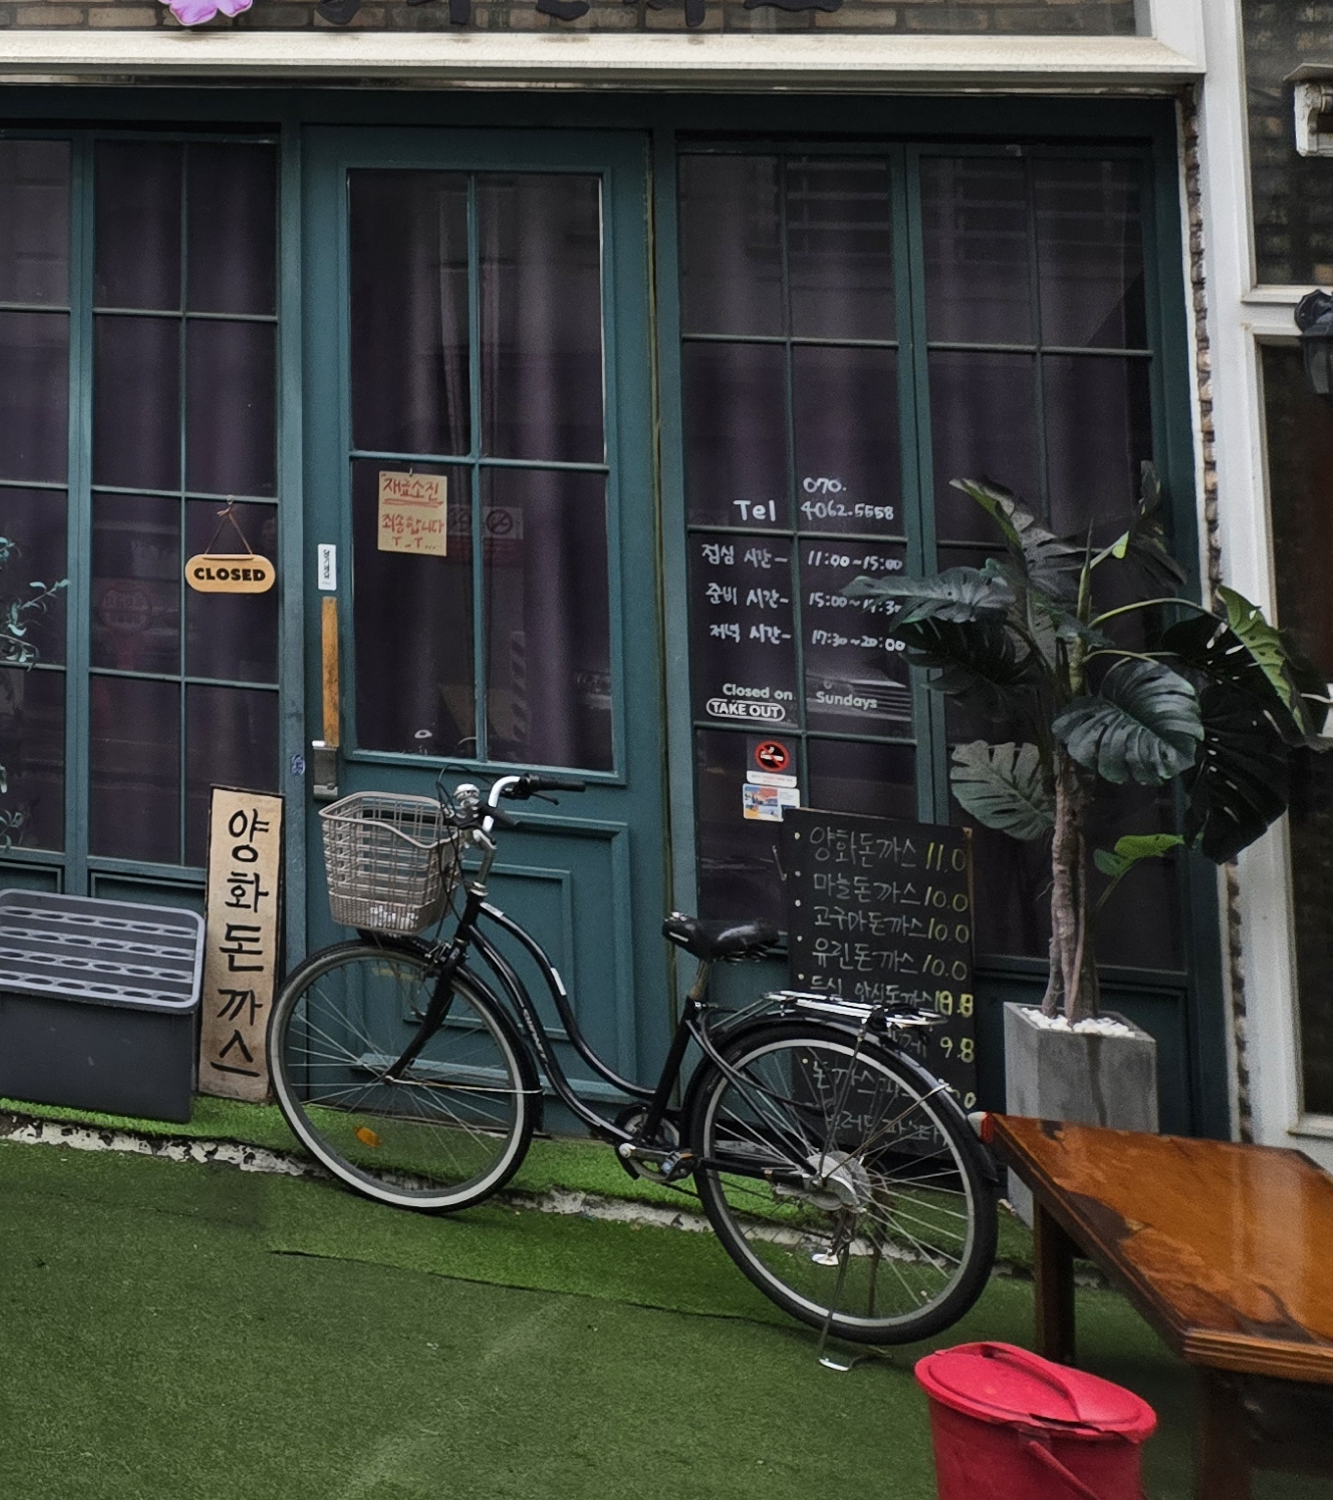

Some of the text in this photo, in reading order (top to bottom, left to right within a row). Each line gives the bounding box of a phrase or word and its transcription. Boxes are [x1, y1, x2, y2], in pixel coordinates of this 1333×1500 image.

[733, 499, 776, 522] Tel
[382, 513, 444, 535] 죄송합니다
[702, 544, 734, 565] 점심
[194, 567, 266, 582] CLOSED
[705, 583, 737, 605] 준비
[710, 623, 740, 643] 저녁
[722, 683, 878, 711] Closed on Sundays
[711, 701, 780, 719] TAKE OUT
[809, 826, 917, 867] 양화돈까스
[813, 871, 969, 912] 마늘돈까스 10.0
[813, 905, 969, 944] 고구마돈까스 10.0
[210, 808, 270, 1077] 양화돈까스
[922, 954, 968, 981] 10.0
